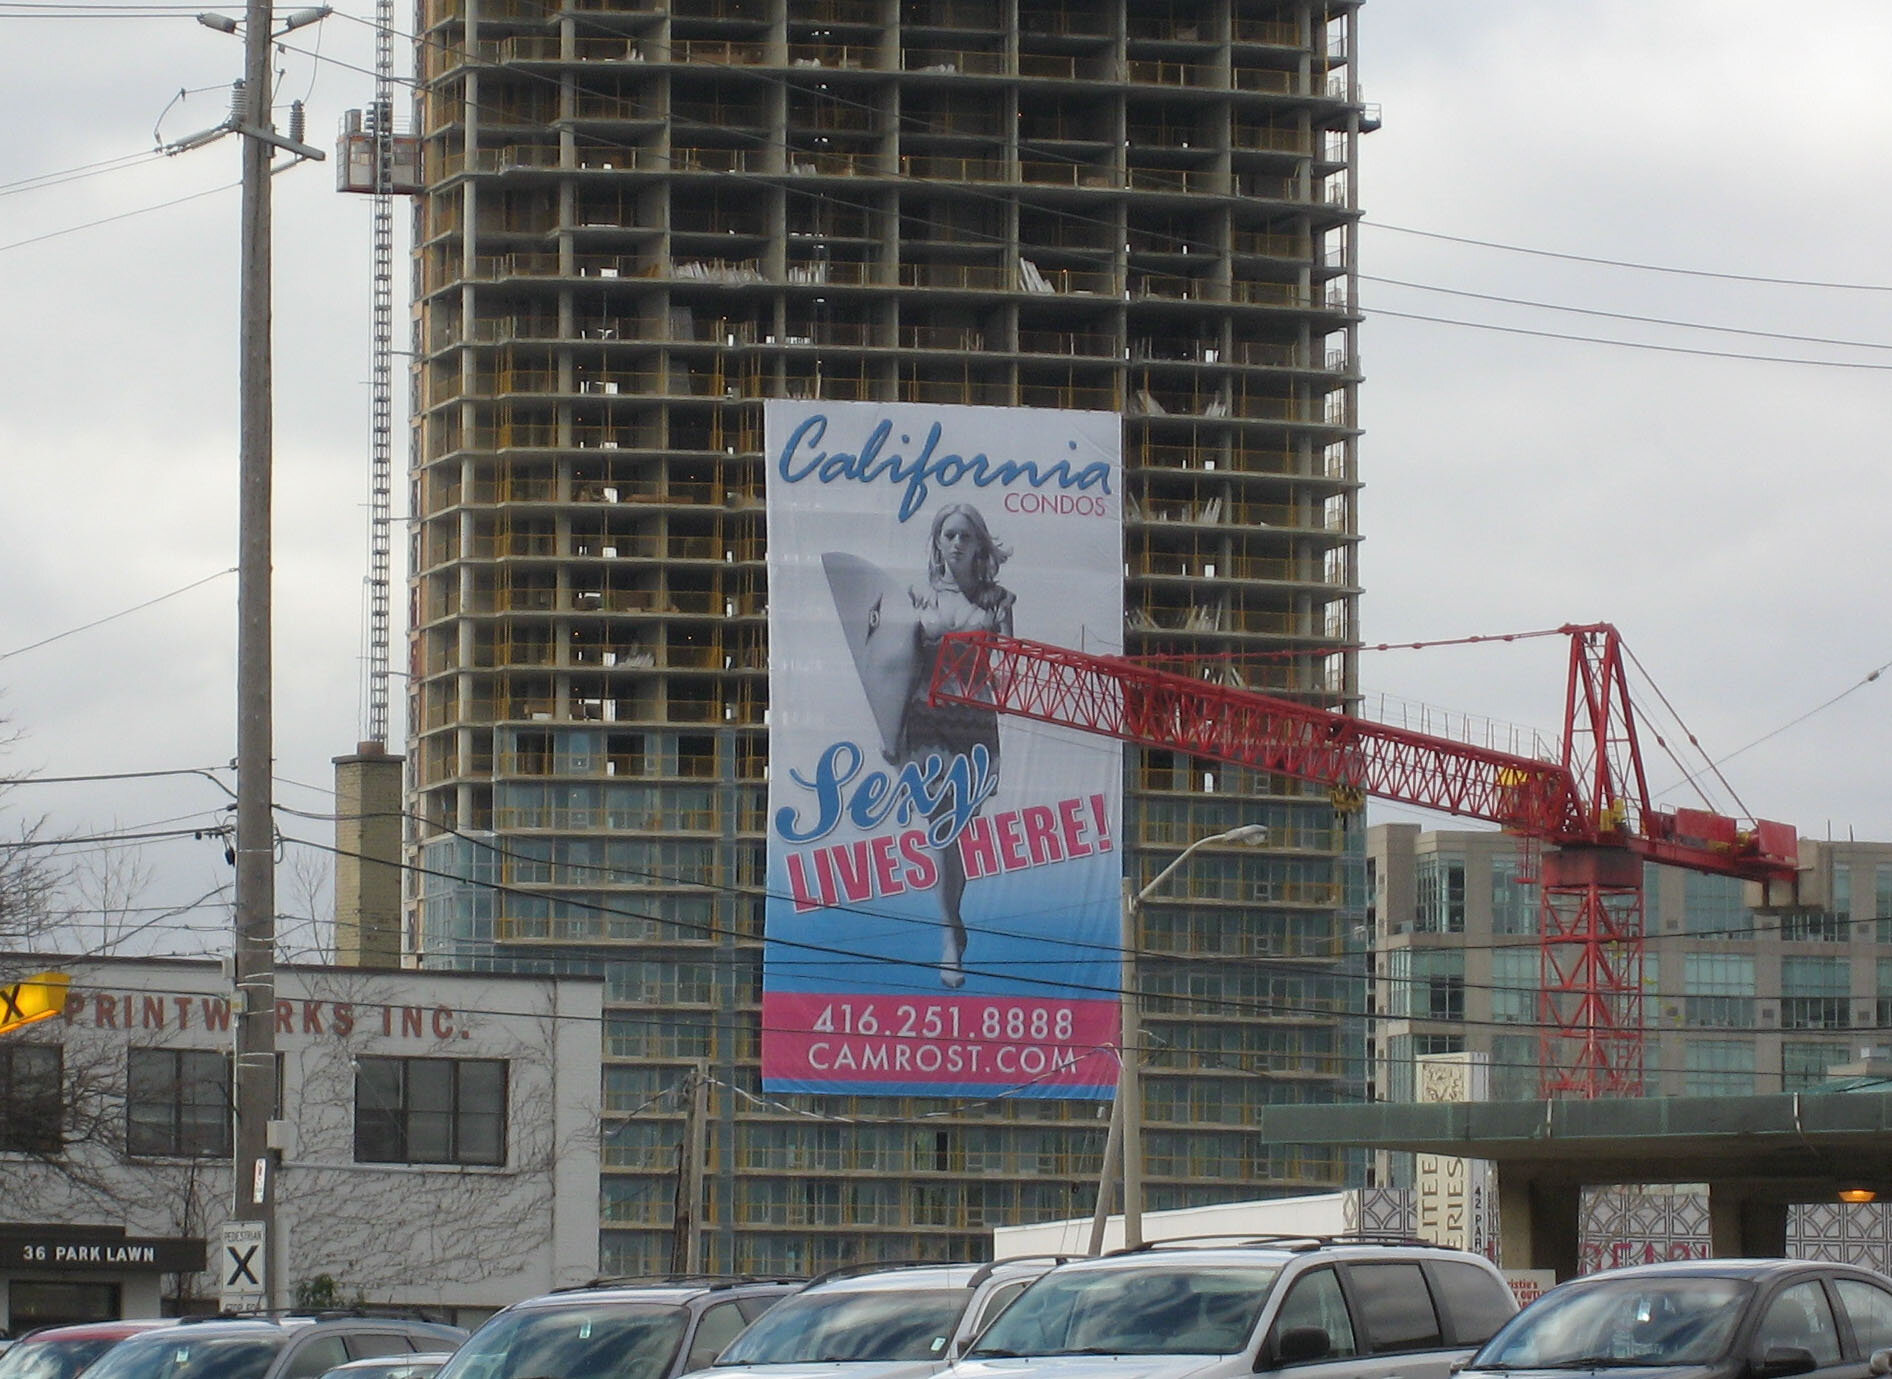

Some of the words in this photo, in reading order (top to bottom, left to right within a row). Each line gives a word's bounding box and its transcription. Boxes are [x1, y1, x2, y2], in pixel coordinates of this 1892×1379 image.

[778, 414, 1112, 523] California
[1004, 492, 1106, 517] CONDOS
[774, 740, 998, 849] Sexy
[784, 829, 939, 914] LIVES
[955, 793, 1114, 880] HERE!
[64, 993, 354, 1037] PRINTWRKS
[383, 1004, 470, 1039] INC.
[812, 1004, 1074, 1040] 416.251.8888
[808, 1042, 1078, 1074] CAMROST.COM
[23, 1245, 46, 1261] 36
[55, 1246, 100, 1262] PARK
[106, 1247, 154, 1262] LAWN
